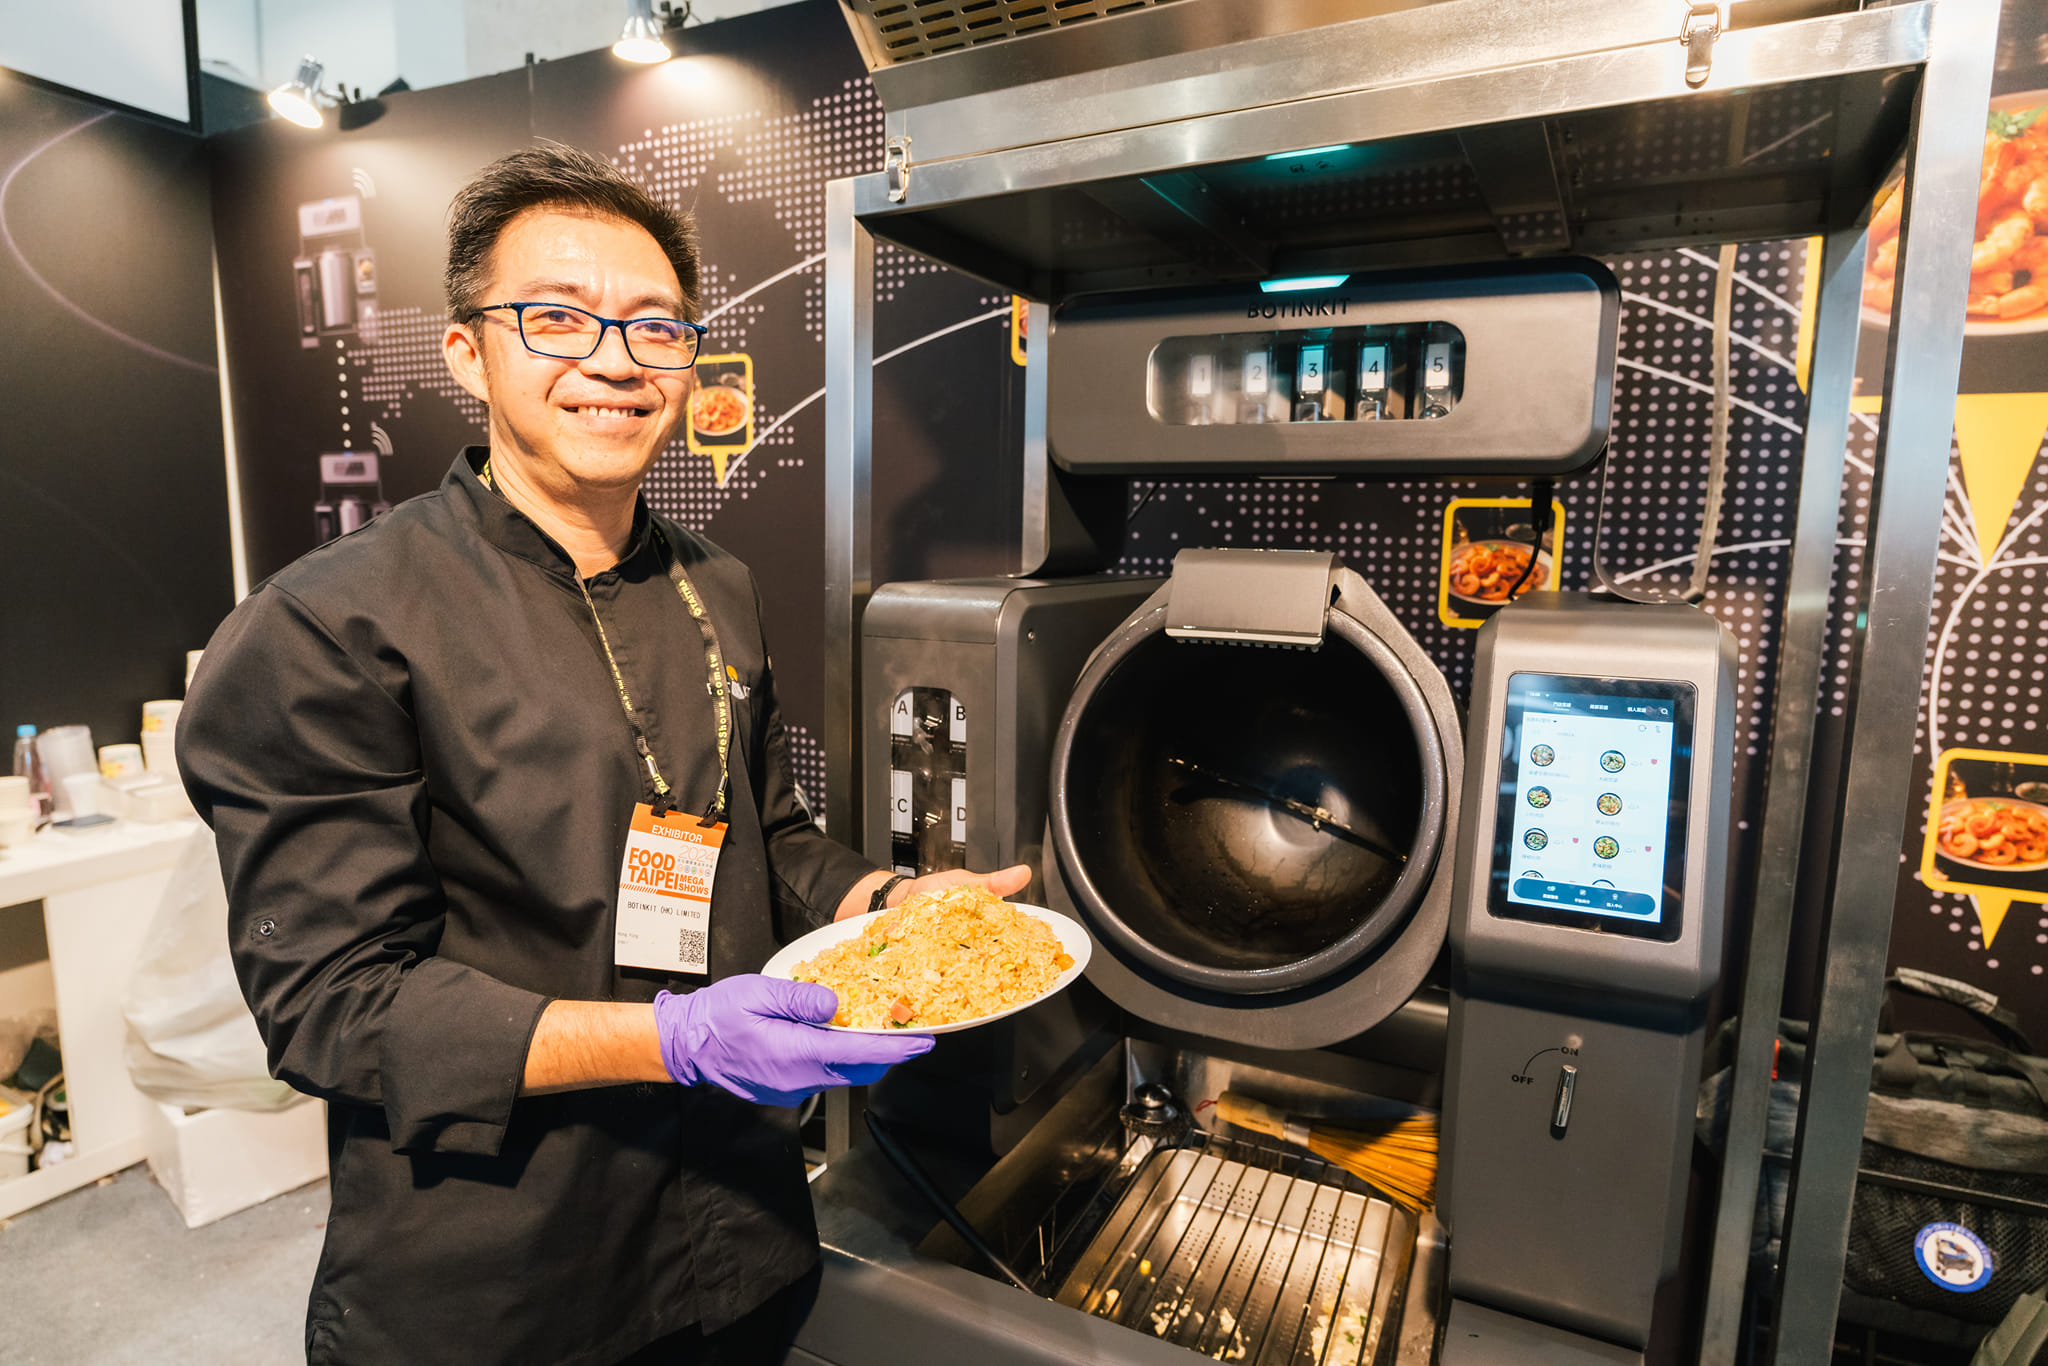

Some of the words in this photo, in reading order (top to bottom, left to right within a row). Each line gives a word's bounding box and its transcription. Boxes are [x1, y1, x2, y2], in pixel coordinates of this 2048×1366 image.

[1247, 297, 1350, 319] BOTINKIT
[1252, 365, 1262, 380] 2
[1307, 362, 1318, 378] 3
[1368, 360, 1379, 376] 4
[1433, 357, 1444, 373] 5
[897, 700, 908, 715] A
[956, 705, 966, 721] B
[897, 799, 908, 813] C
[957, 807, 967, 821] D
[652, 824, 703, 843] EXHIBITOR
[628, 847, 676, 871] FOOD
[678, 844, 715, 863] 2024
[627, 865, 680, 890] TAIPEI
[679, 874, 704, 885] MEGA
[678, 883, 709, 895] SHOWS
[627, 901, 657, 912] BOTINKIT
[676, 908, 701, 919] LIMITED
[1561, 1046, 1579, 1056] ON
[1511, 1074, 1534, 1085] OFF
